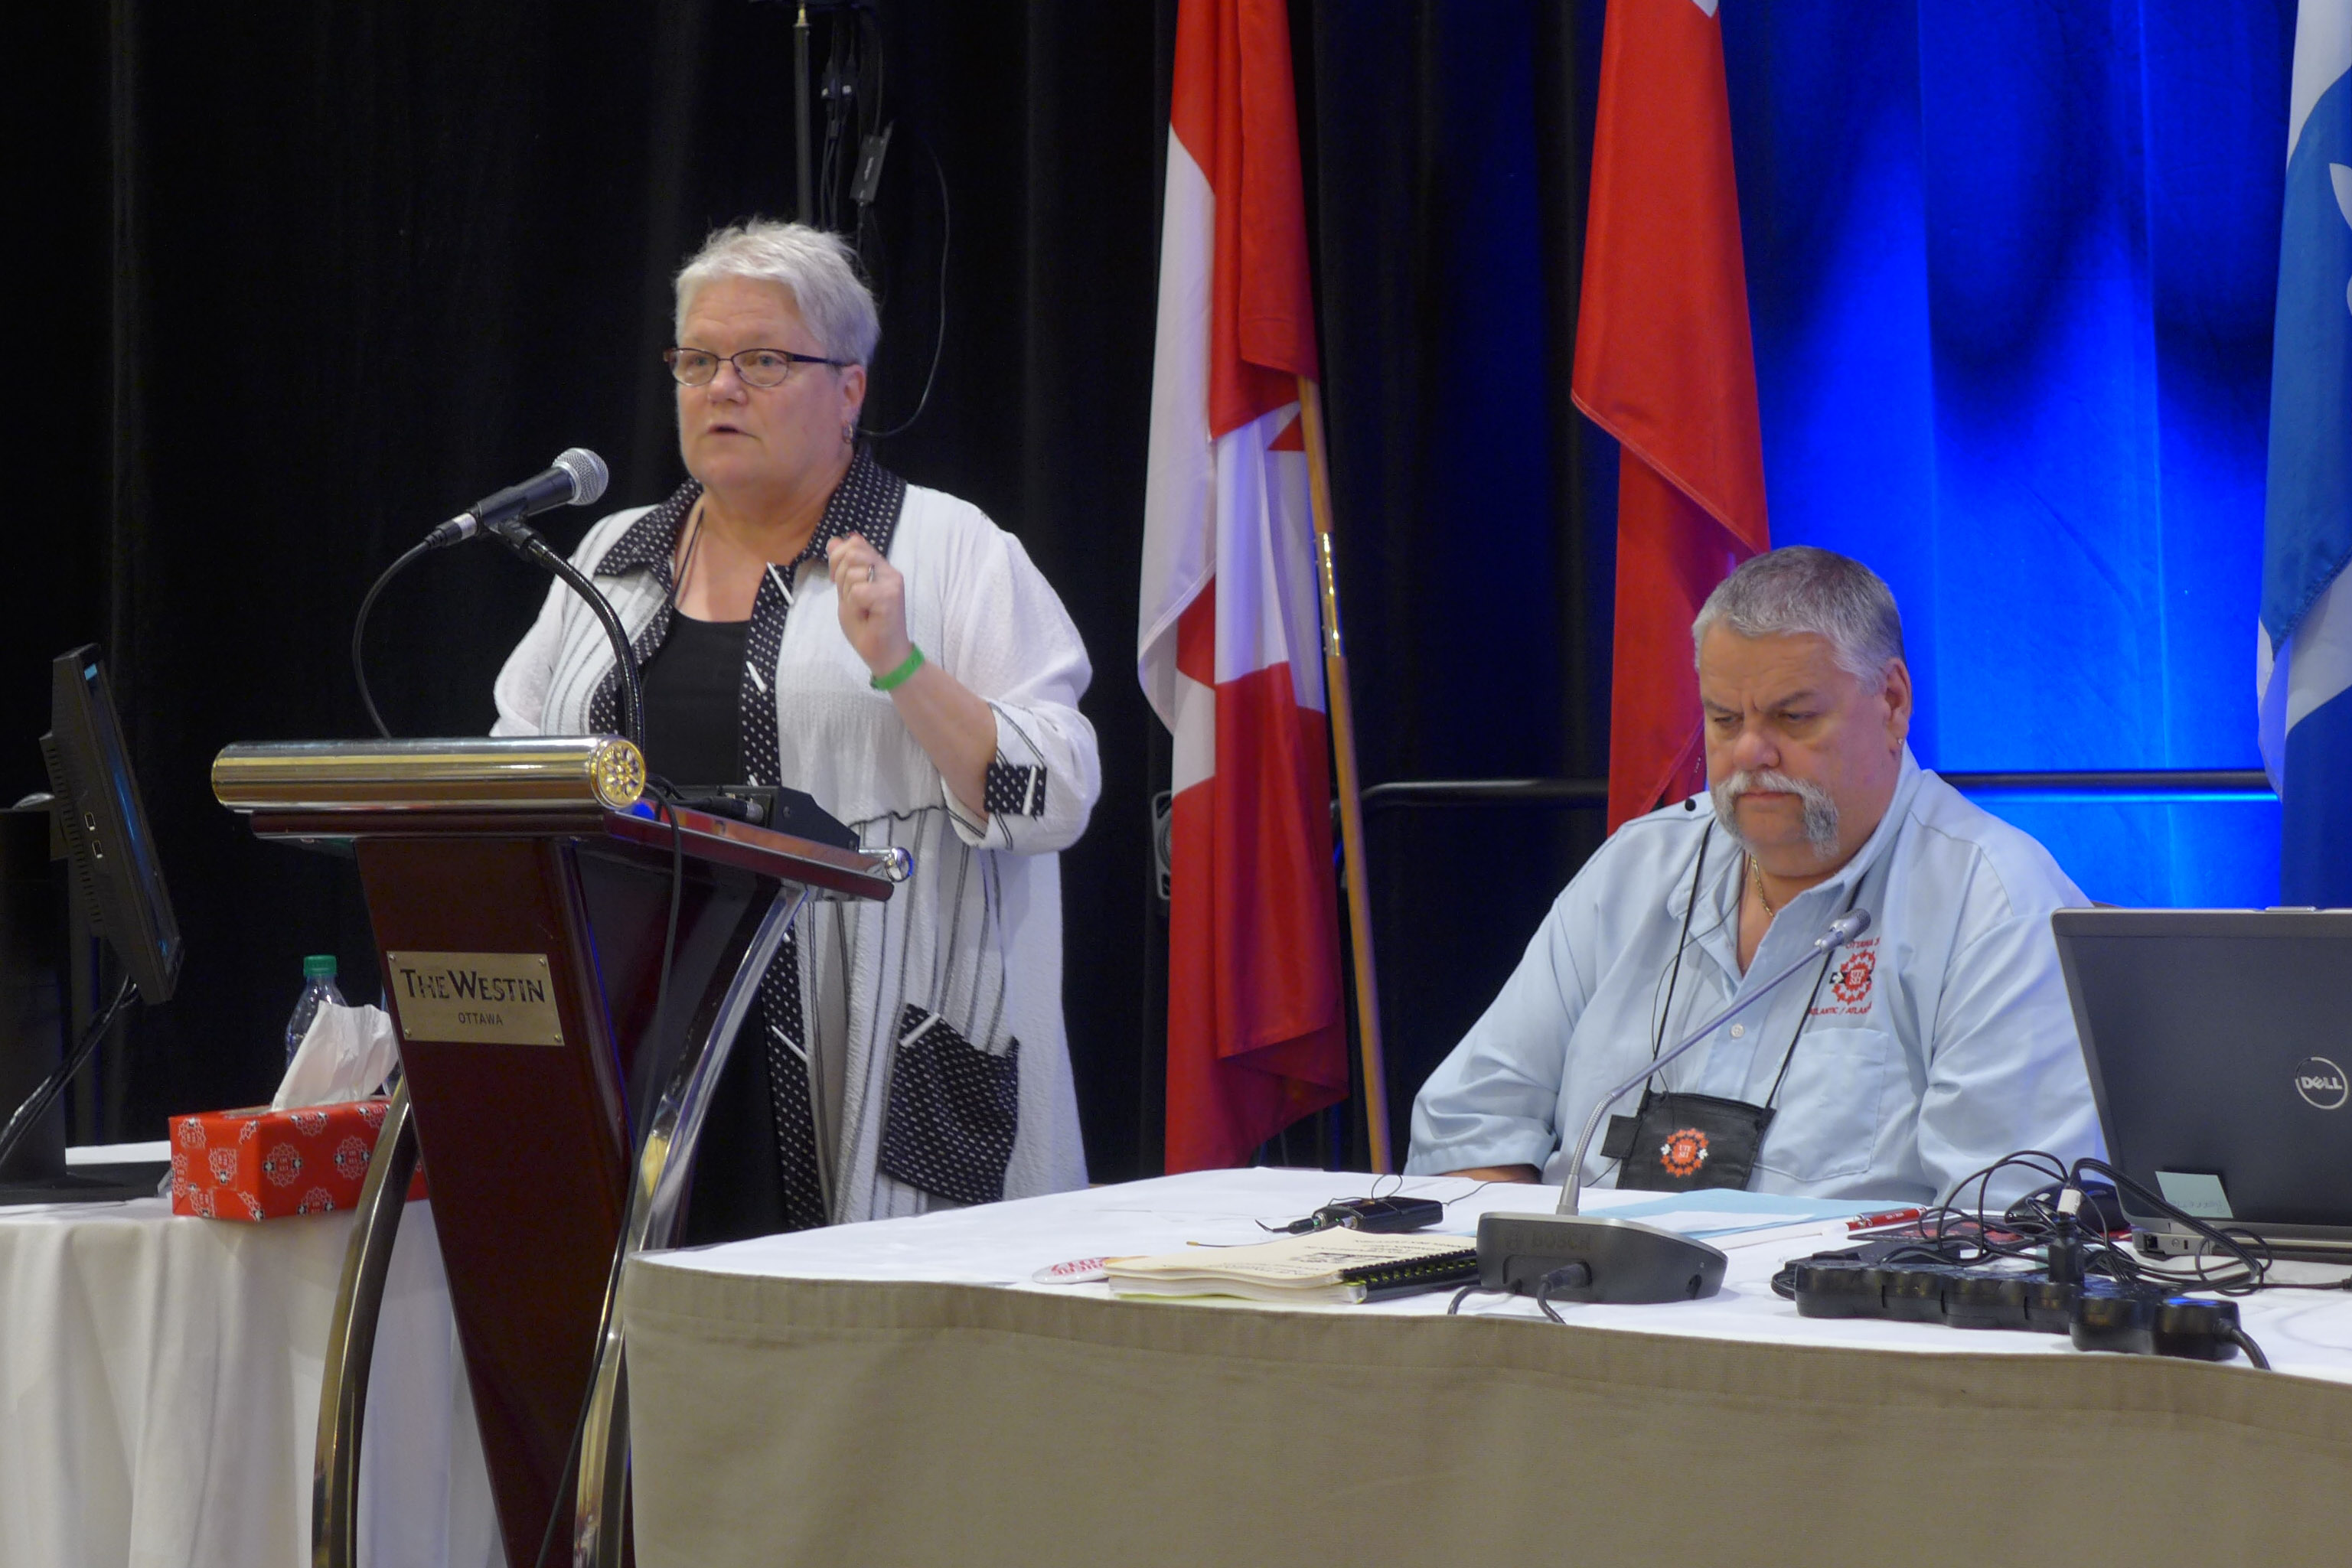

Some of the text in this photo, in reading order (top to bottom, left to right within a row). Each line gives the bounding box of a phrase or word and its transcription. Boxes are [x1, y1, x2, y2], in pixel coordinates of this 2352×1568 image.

[400, 968, 546, 1003] THE WESTIN
[458, 1012, 504, 1026] OTTAWA
[2301, 1075, 2343, 1090] DELL
